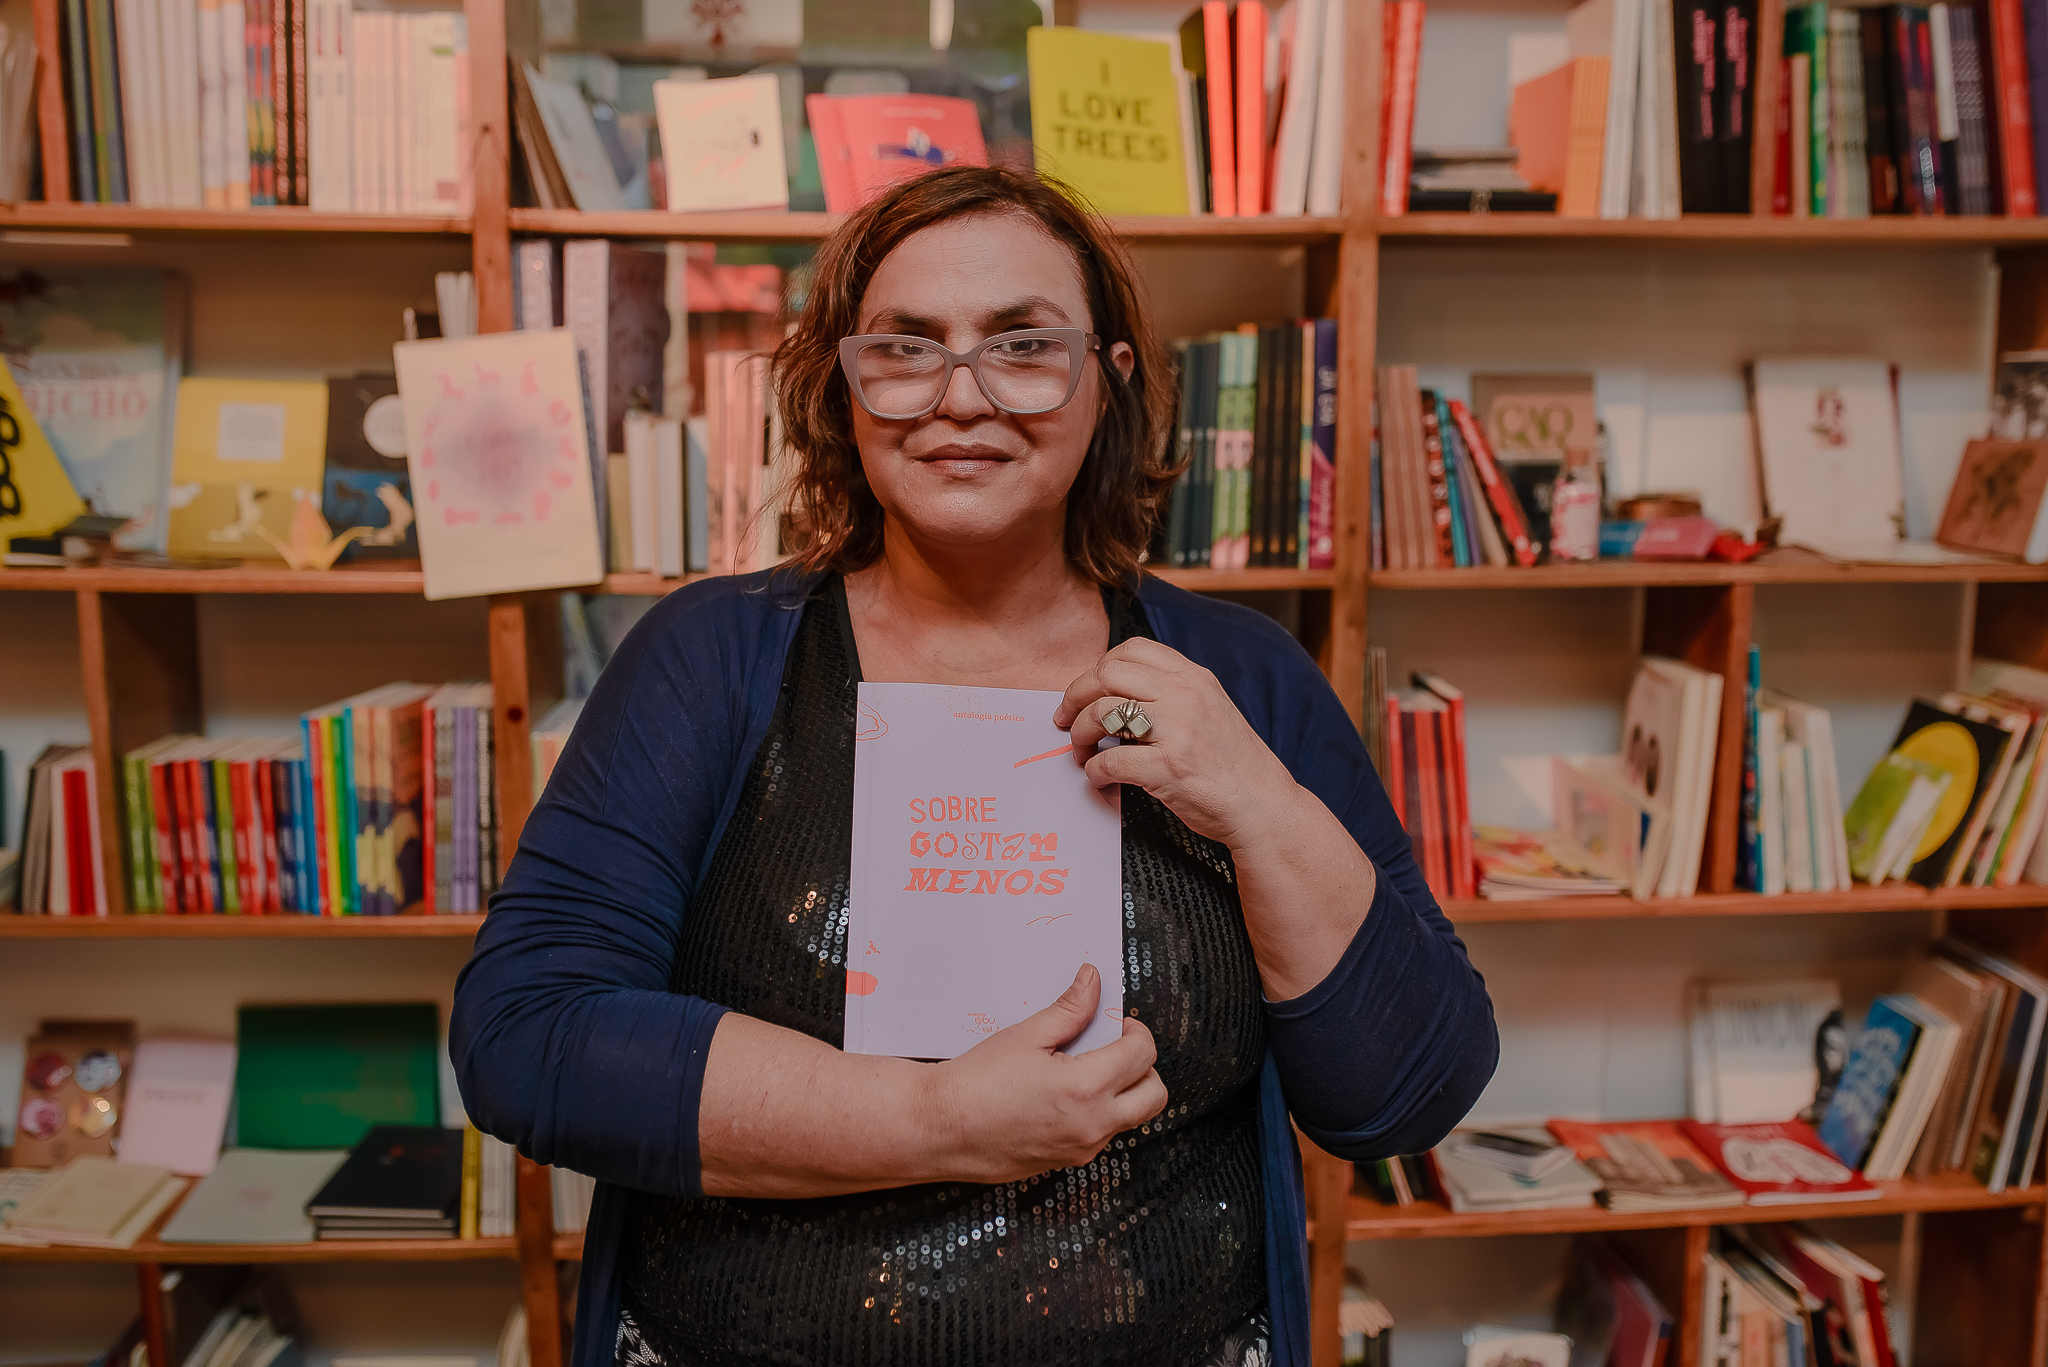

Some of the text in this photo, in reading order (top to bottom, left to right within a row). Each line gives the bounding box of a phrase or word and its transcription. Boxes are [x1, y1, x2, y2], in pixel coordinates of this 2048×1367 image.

[1100, 59, 1110, 85] I
[1058, 88, 1154, 128] LOVE
[1052, 122, 1169, 164] TREES
[953, 711, 1025, 722] antologia poética
[909, 795, 998, 824] SOBRE
[902, 867, 1071, 896] MENOS
